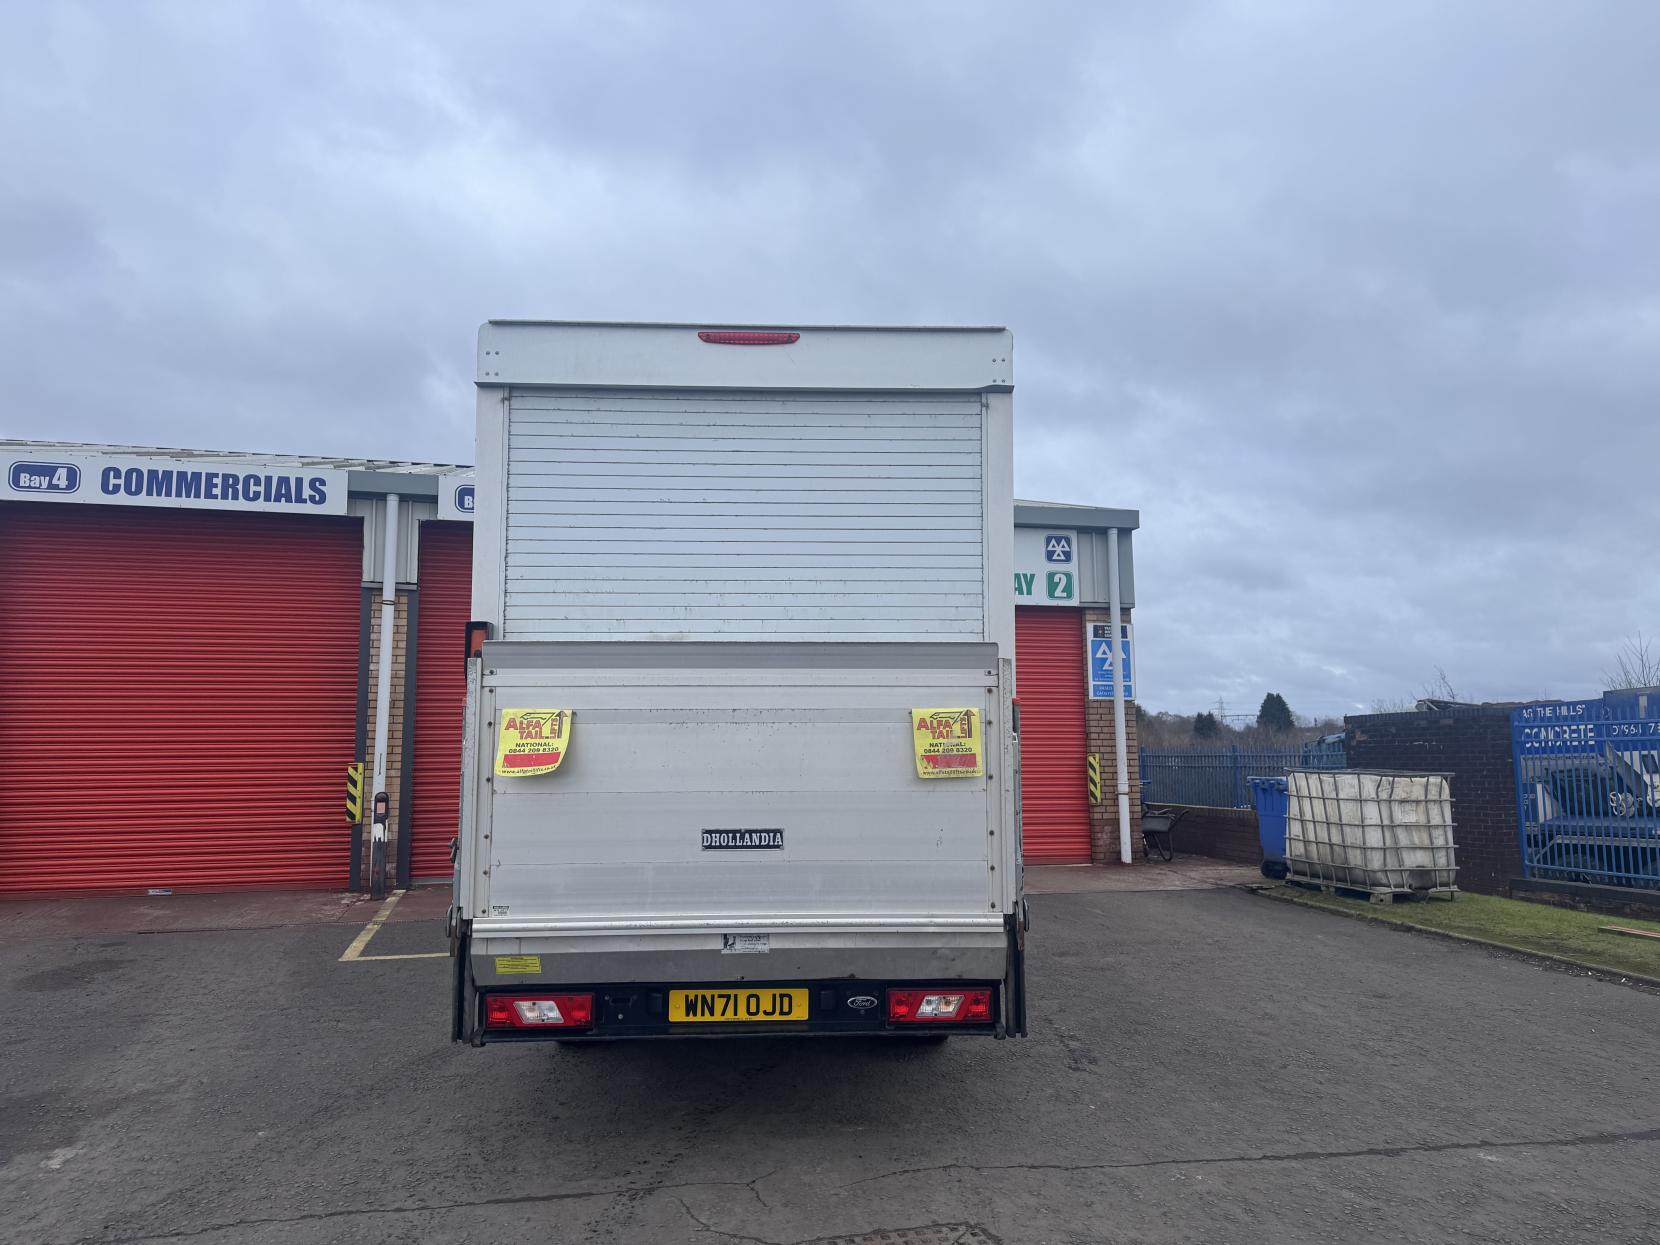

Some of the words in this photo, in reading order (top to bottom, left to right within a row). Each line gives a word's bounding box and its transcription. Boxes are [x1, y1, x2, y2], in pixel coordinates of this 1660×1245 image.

[19, 472, 50, 489] Bay
[52, 467, 69, 489] 4
[100, 466, 327, 505] COMMERCIALS
[1014, 573, 1036, 596] AY
[1053, 573, 1067, 598] 2
[504, 717, 543, 731] ALFA
[518, 730, 545, 740] TAIL
[917, 717, 953, 731] ALFA
[1524, 724, 1595, 748] CONCRETE
[702, 832, 783, 846] DHOLLANDIA
[684, 993, 738, 1017] WN71
